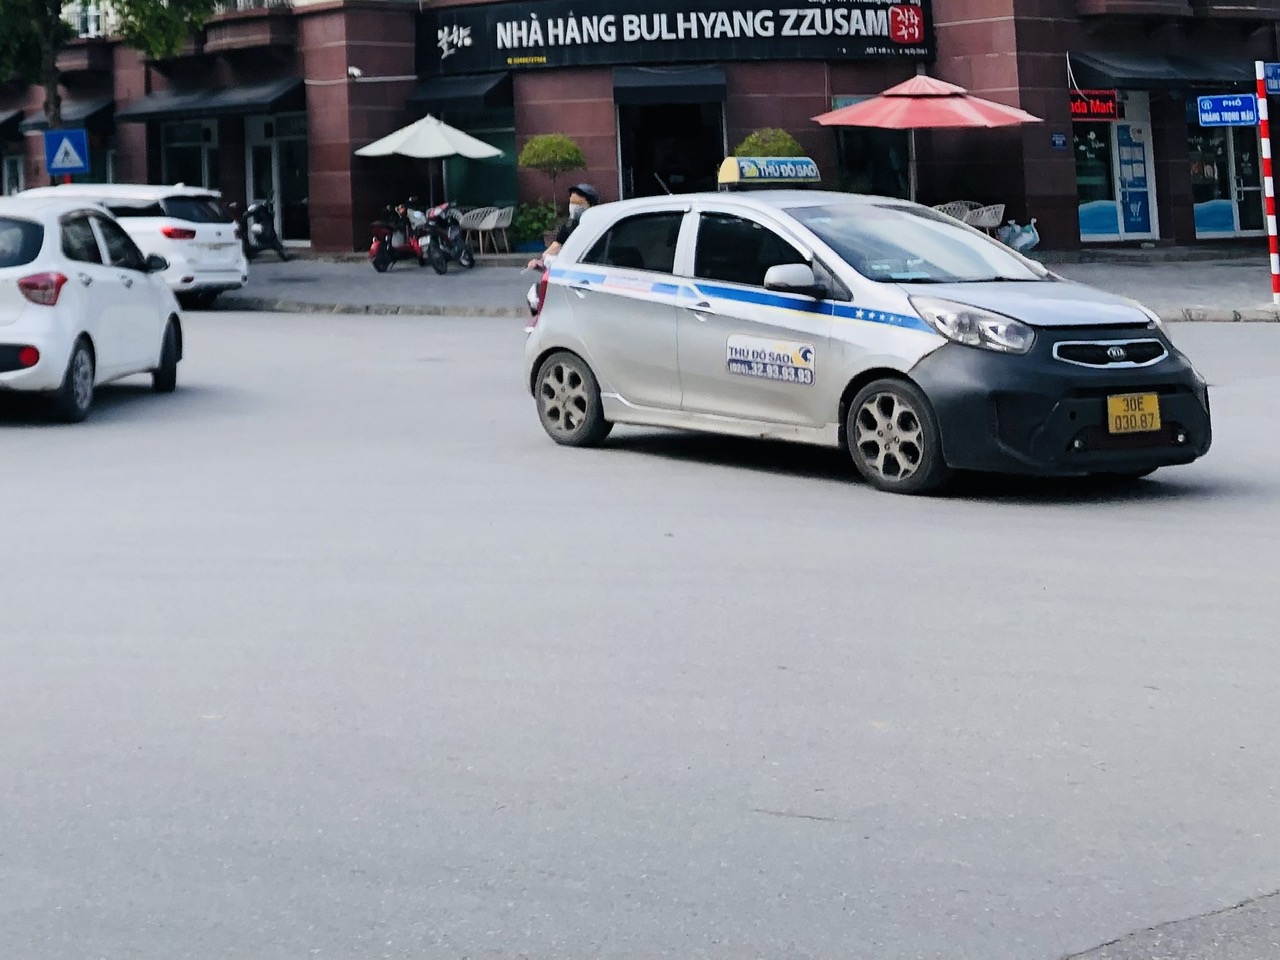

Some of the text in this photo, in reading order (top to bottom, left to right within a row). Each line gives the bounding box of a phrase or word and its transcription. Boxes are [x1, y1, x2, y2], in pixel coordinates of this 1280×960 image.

[496, 12, 544, 49] NHÀ
[622, 10, 774, 41] BULHYANG
[778, 7, 888, 37] ZZUSAM
[1090, 100, 1114, 114] Mart
[768, 351, 790, 363] SAO
[1122, 396, 1145, 412] 30E
[1114, 413, 1155, 431] 030.87
